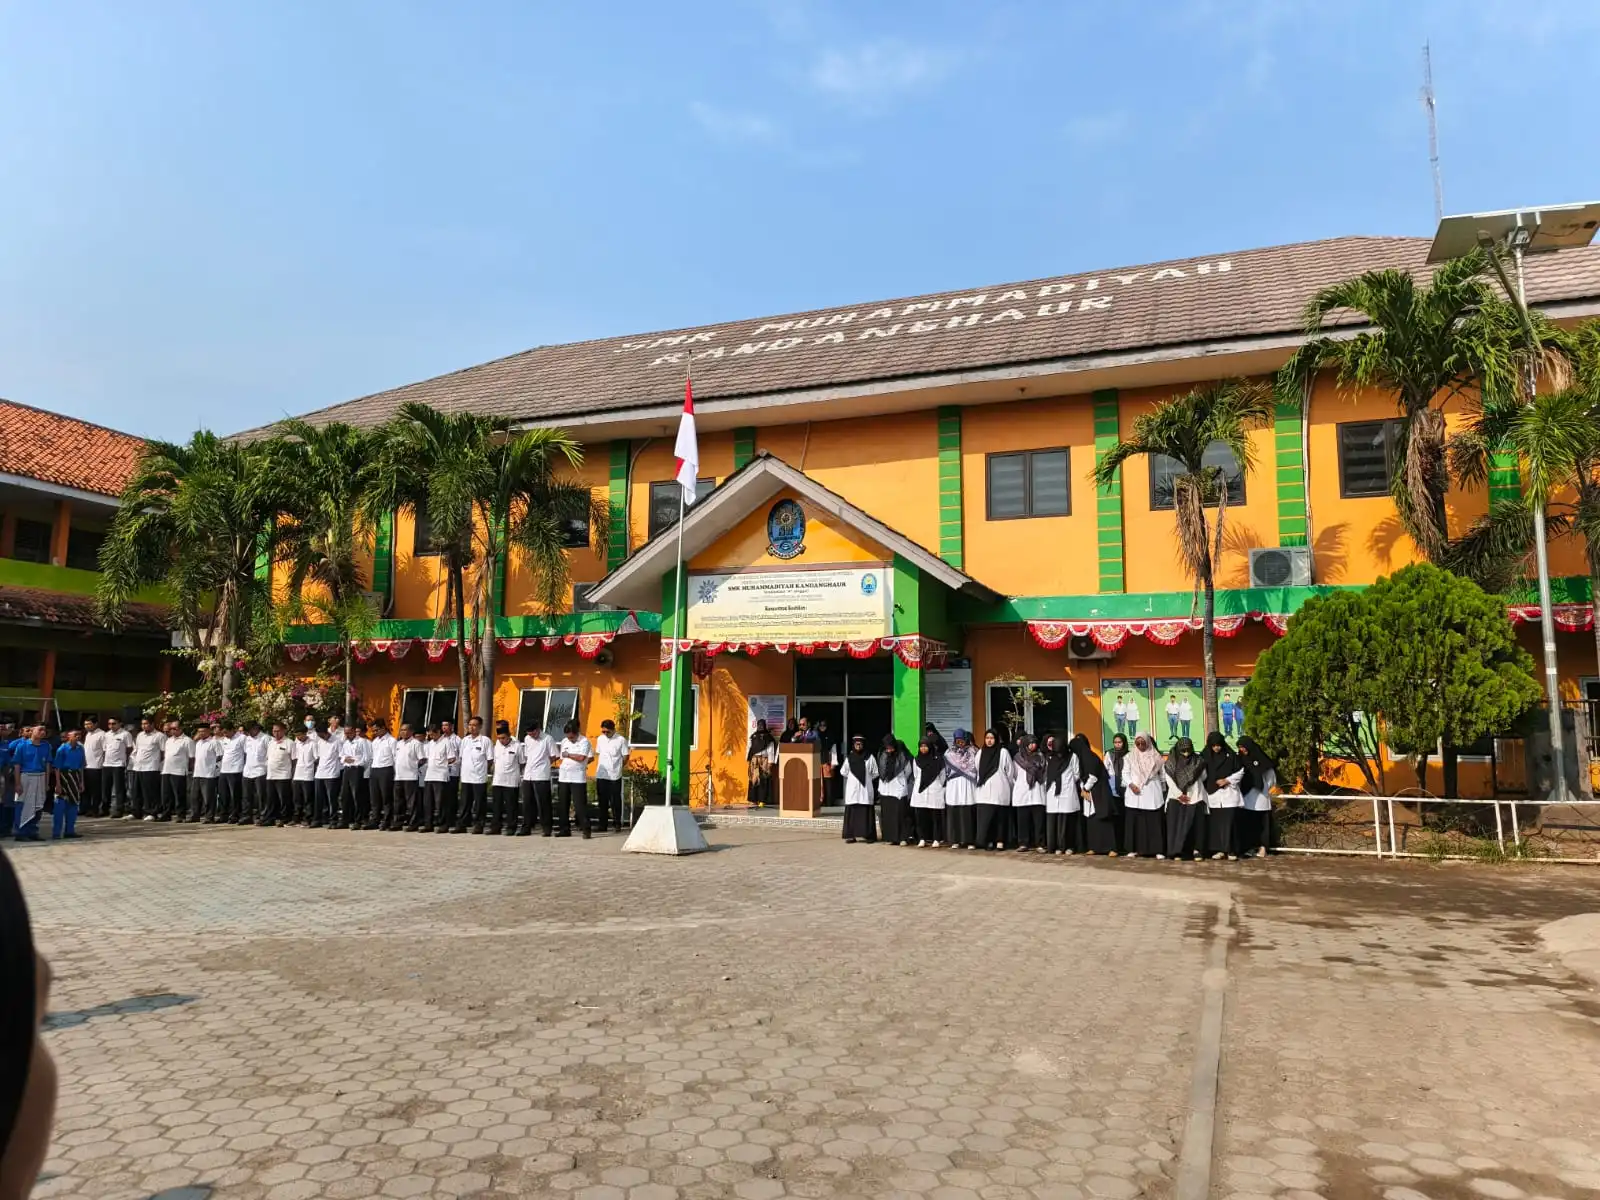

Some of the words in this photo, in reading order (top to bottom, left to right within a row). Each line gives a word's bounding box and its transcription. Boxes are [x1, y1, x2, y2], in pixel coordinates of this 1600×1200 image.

[614, 330, 724, 353] SMK
[752, 260, 1232, 336] MUHAMMADIYAH
[649, 295, 1114, 367] KANDANGHAUR
[742, 583, 794, 591] MUHAMMADIYAH
[795, 581, 847, 589] KANDANGHAUR
